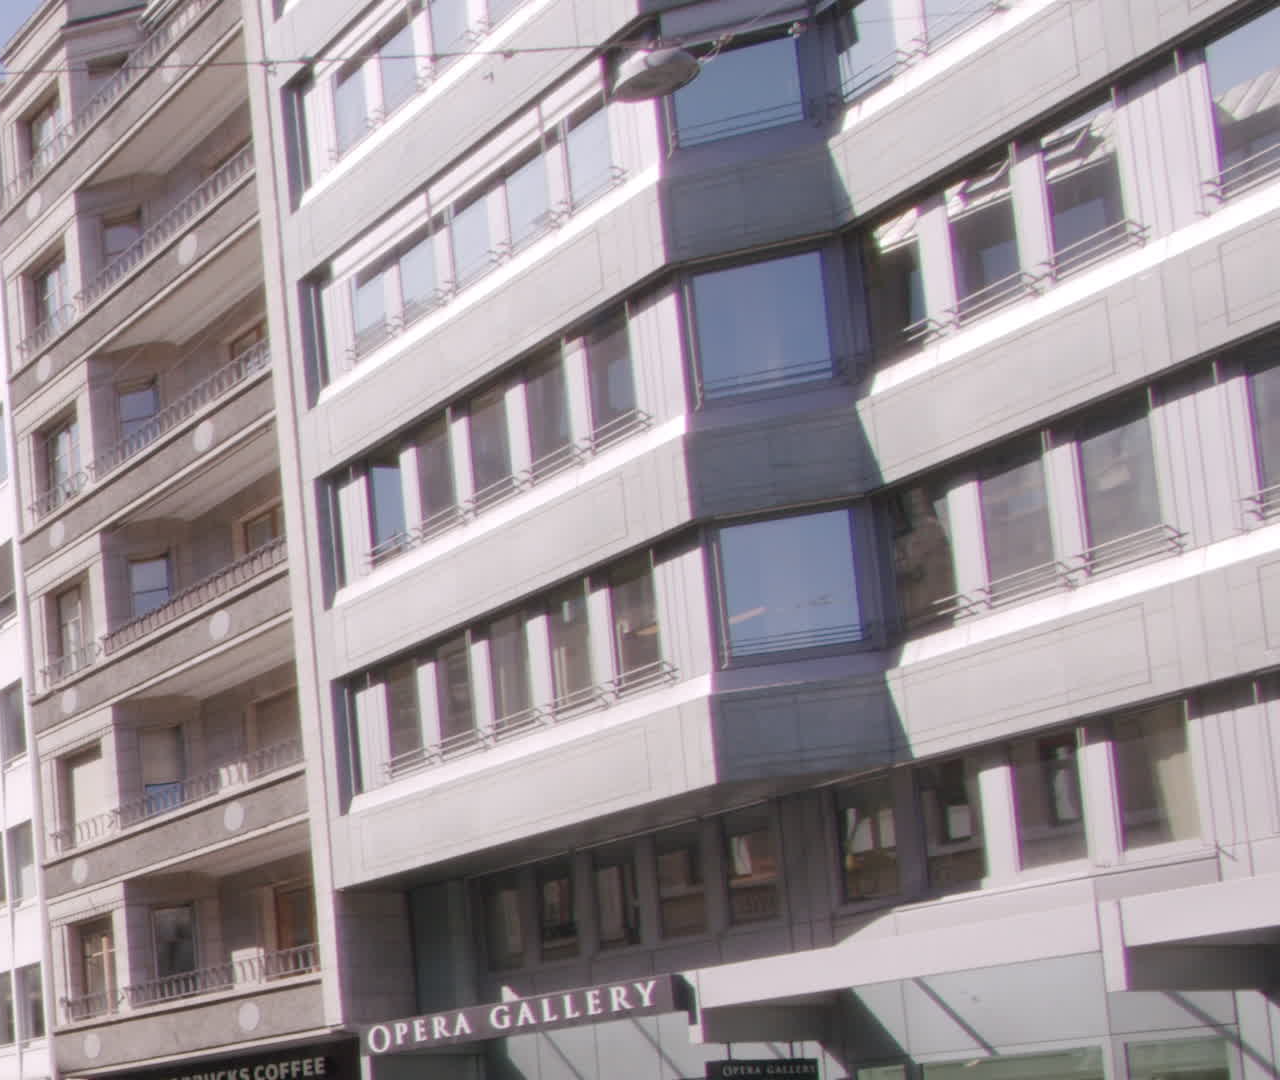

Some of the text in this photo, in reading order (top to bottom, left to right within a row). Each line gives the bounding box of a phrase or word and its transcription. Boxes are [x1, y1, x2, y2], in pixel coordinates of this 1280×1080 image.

[368, 979, 657, 1053] OPERA GALLERY
[767, 1063, 817, 1074] GALLERY
